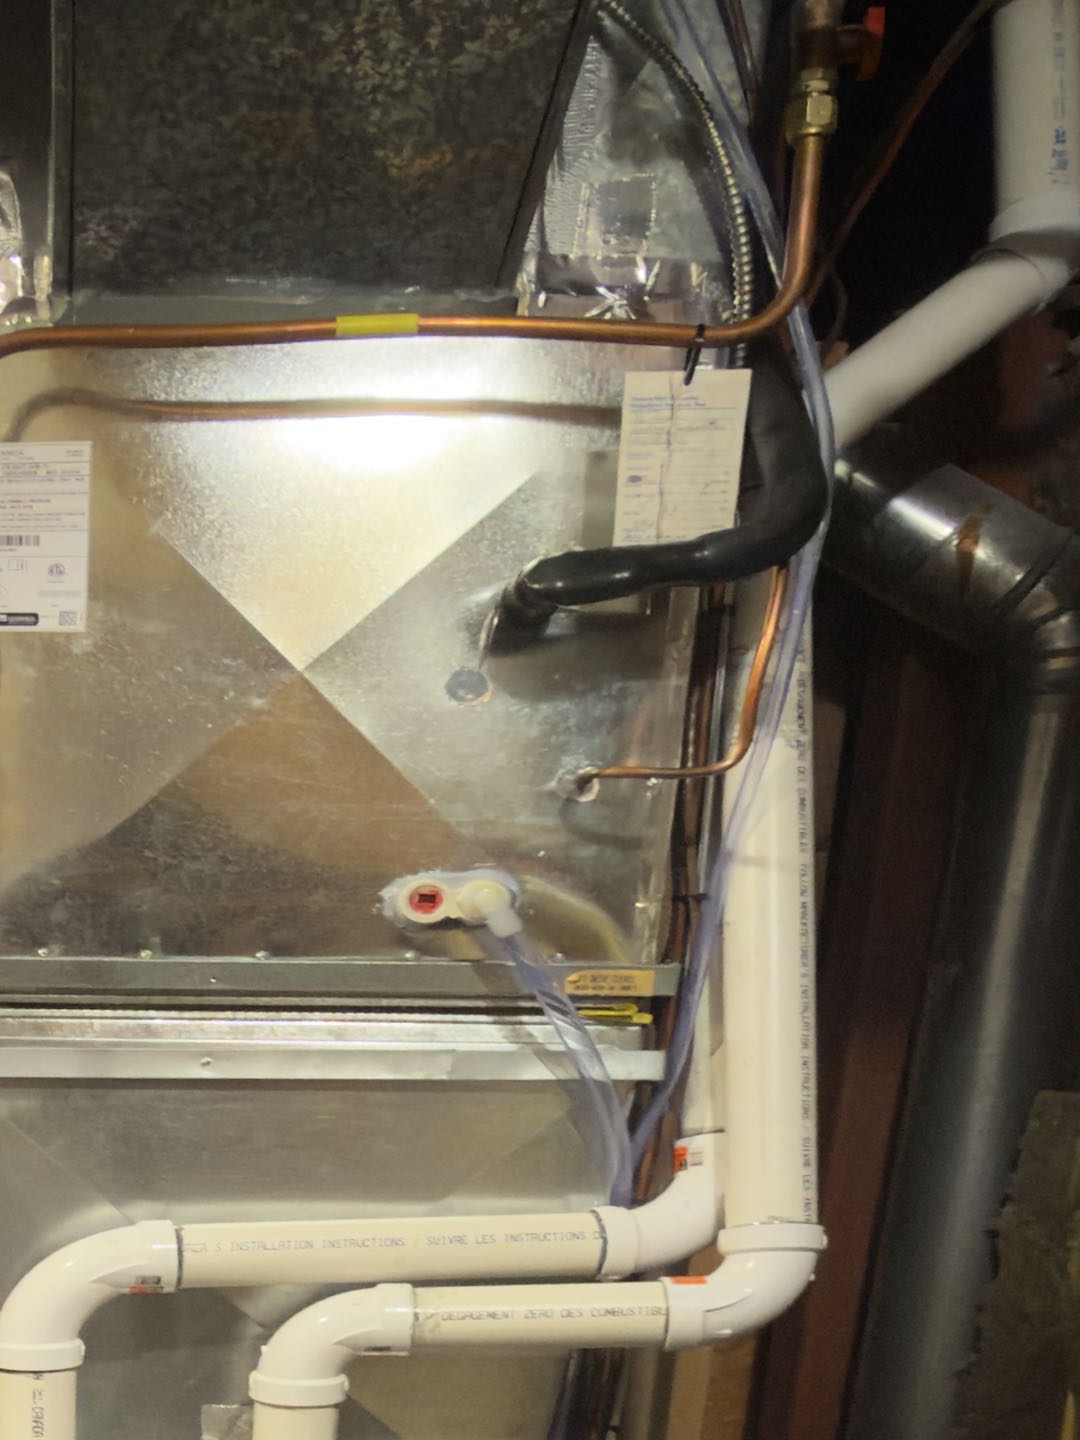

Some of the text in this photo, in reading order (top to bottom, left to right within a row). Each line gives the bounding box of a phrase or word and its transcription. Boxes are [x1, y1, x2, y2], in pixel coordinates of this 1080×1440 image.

[229, 1239, 314, 1251] INSTALLATION
[322, 1236, 405, 1249] INSTRUCTIONS
[426, 1234, 468, 1246] SUIVRE
[474, 1233, 496, 1245] LES
[504, 1230, 587, 1243] INSTRUCTIONS
[523, 1308, 554, 1320] ZERO
[560, 1307, 583, 1319] DES
